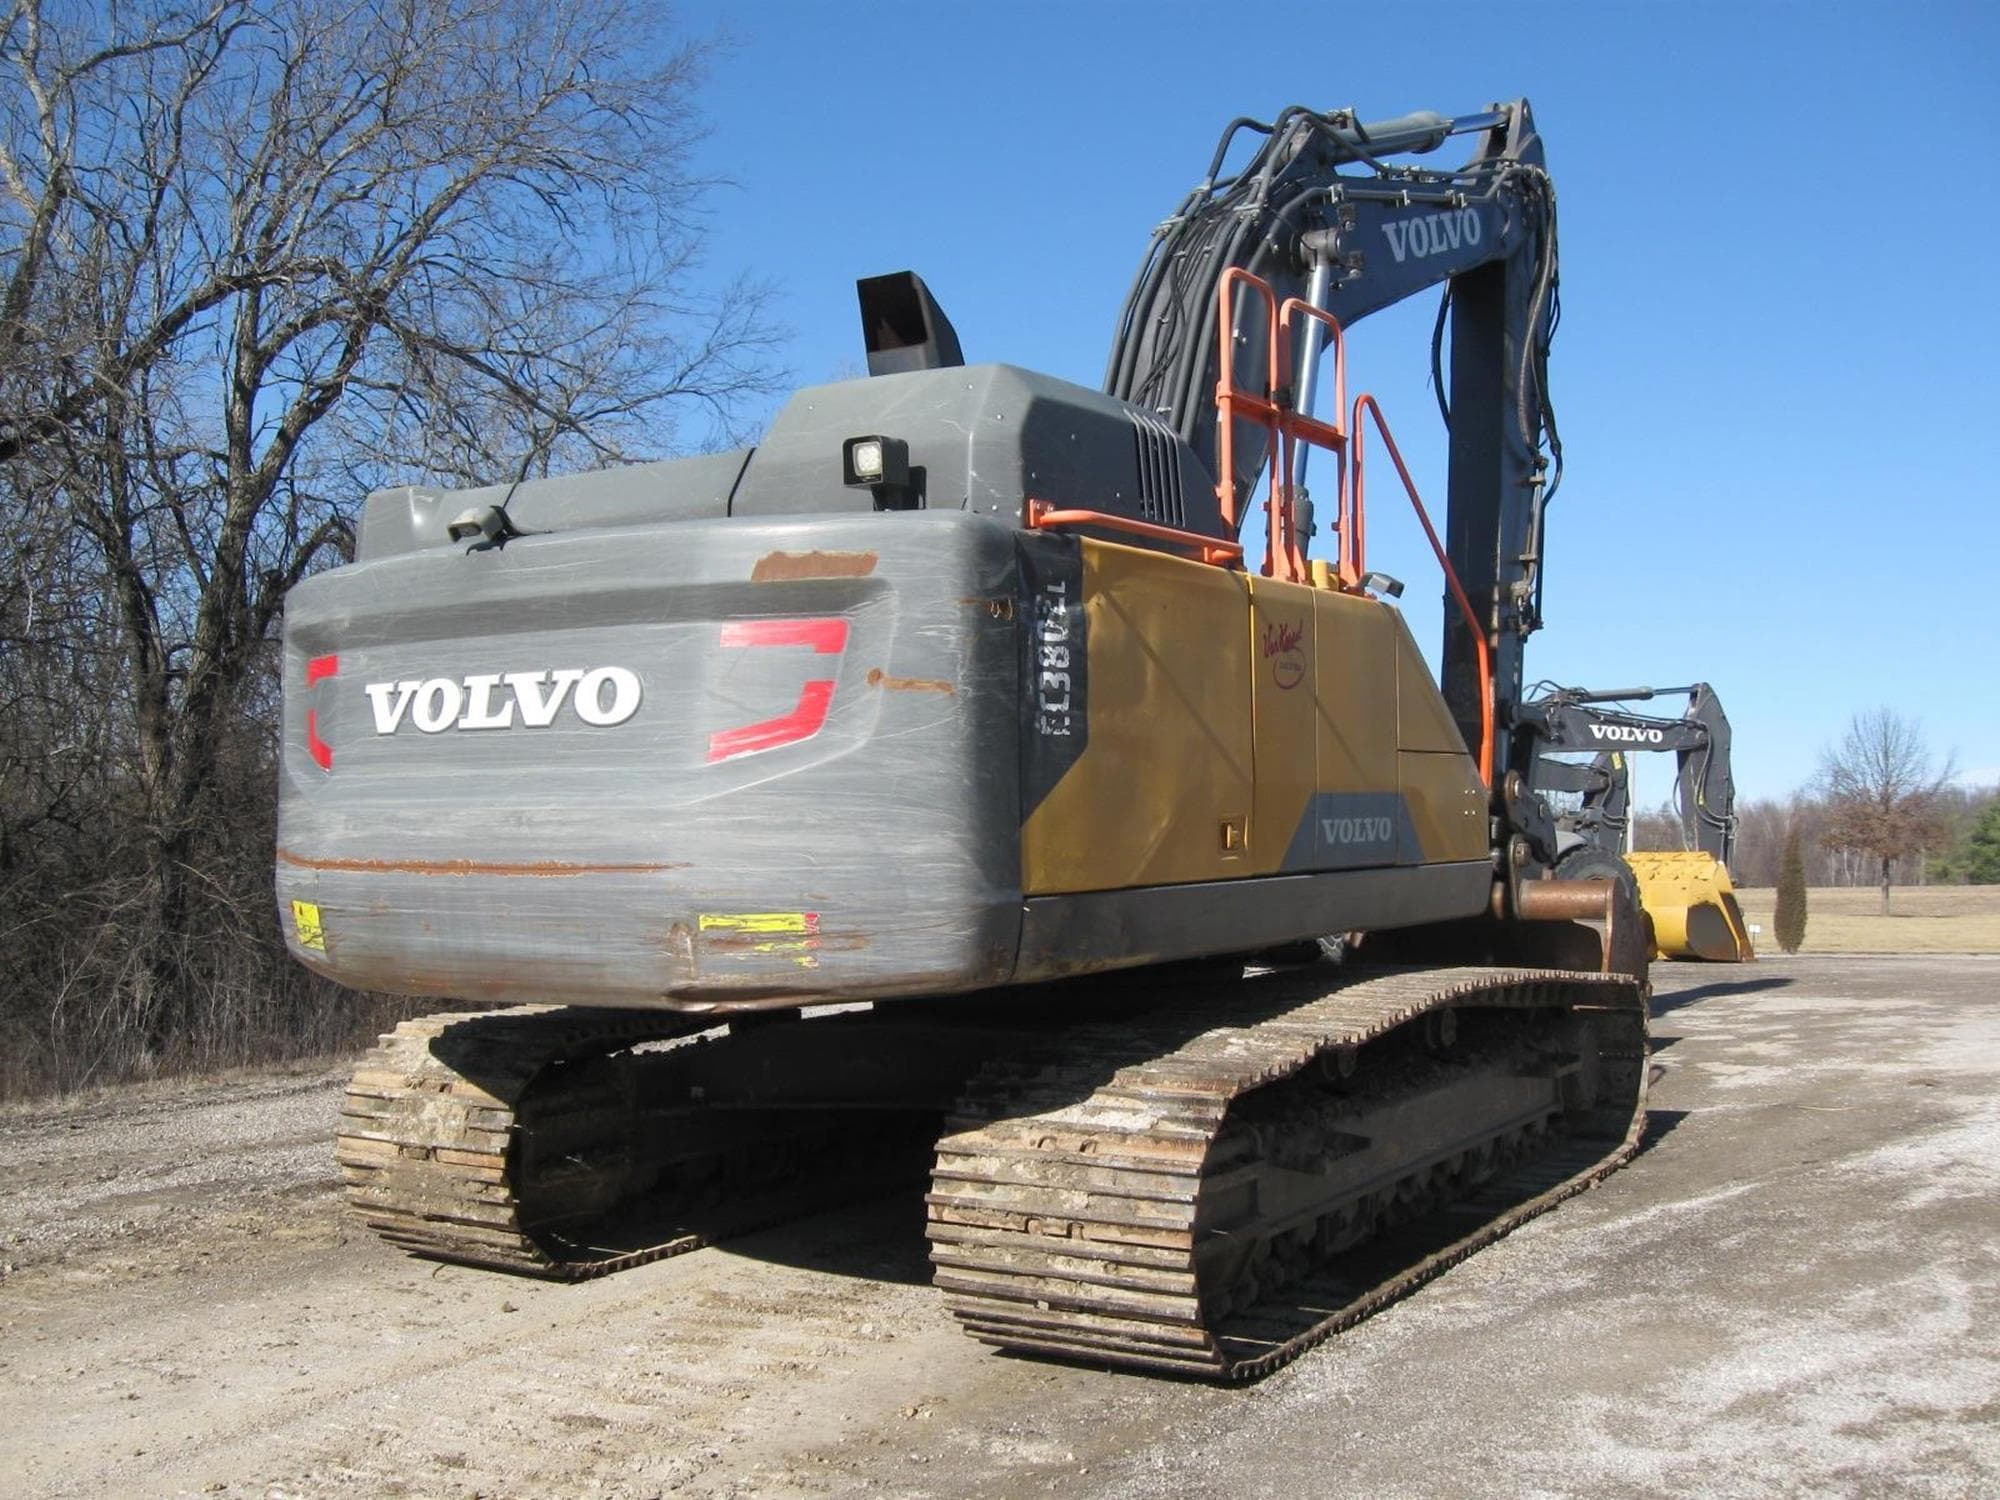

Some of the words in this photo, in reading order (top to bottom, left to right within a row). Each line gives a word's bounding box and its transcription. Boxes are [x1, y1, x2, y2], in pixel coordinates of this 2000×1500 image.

[1382, 208, 1481, 263] VOLVO
[365, 666, 643, 735] VOLVO
[1589, 724, 1663, 743] VOLVO
[1321, 817, 1392, 845] VOLVO
